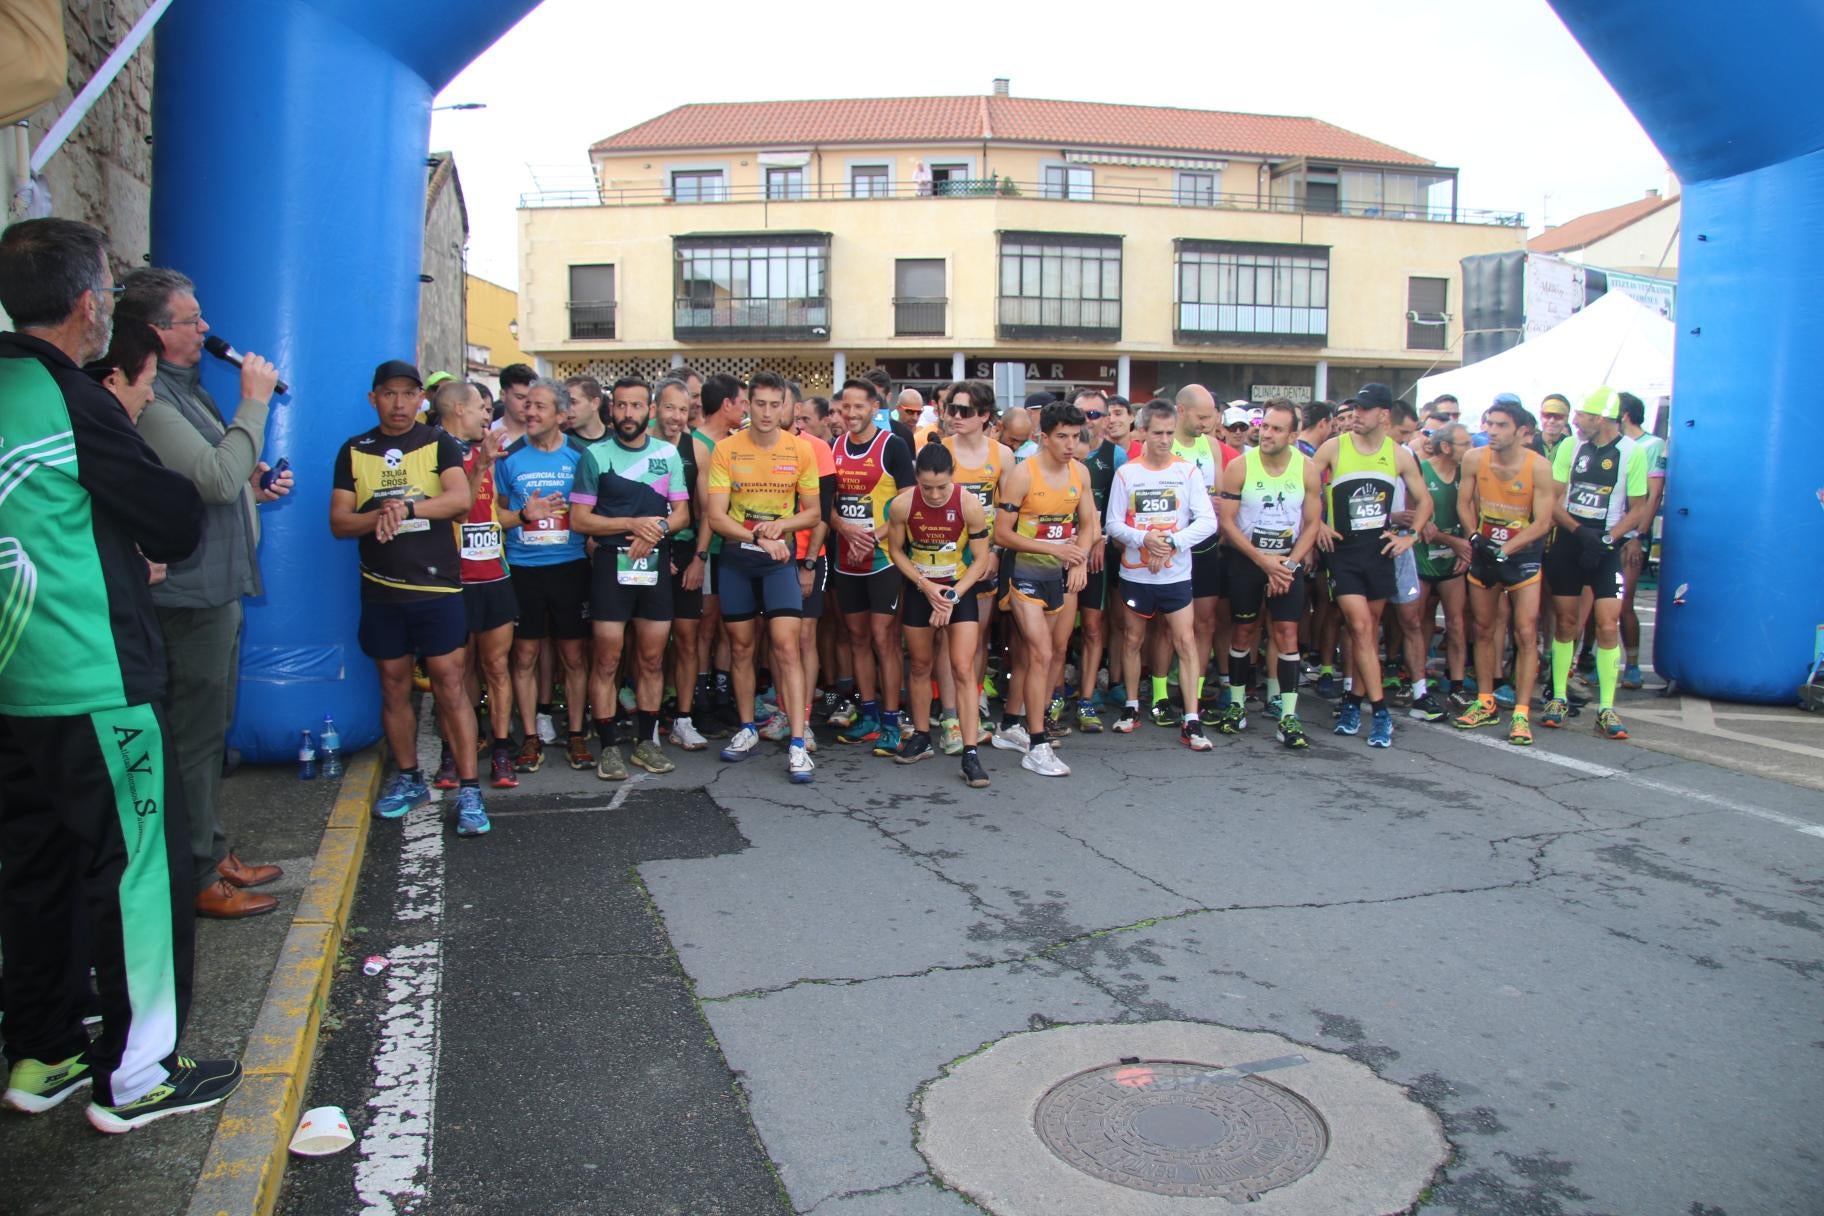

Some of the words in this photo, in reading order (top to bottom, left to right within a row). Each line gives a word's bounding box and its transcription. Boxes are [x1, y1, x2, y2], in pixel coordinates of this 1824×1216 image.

[1284, 387, 1310, 399] DENTAL
[381, 478, 408, 487] CROSS
[517, 472, 556, 481] COMERCIAL
[1142, 499, 1168, 511] 250
[1577, 492, 1600, 507] 471
[841, 504, 866, 518] 202
[1357, 504, 1382, 517] 452
[538, 517, 555, 529] 51
[1047, 526, 1062, 538] 38
[467, 531, 498, 548] 1009
[1259, 537, 1284, 549] 573
[929, 553, 936, 565] 1
